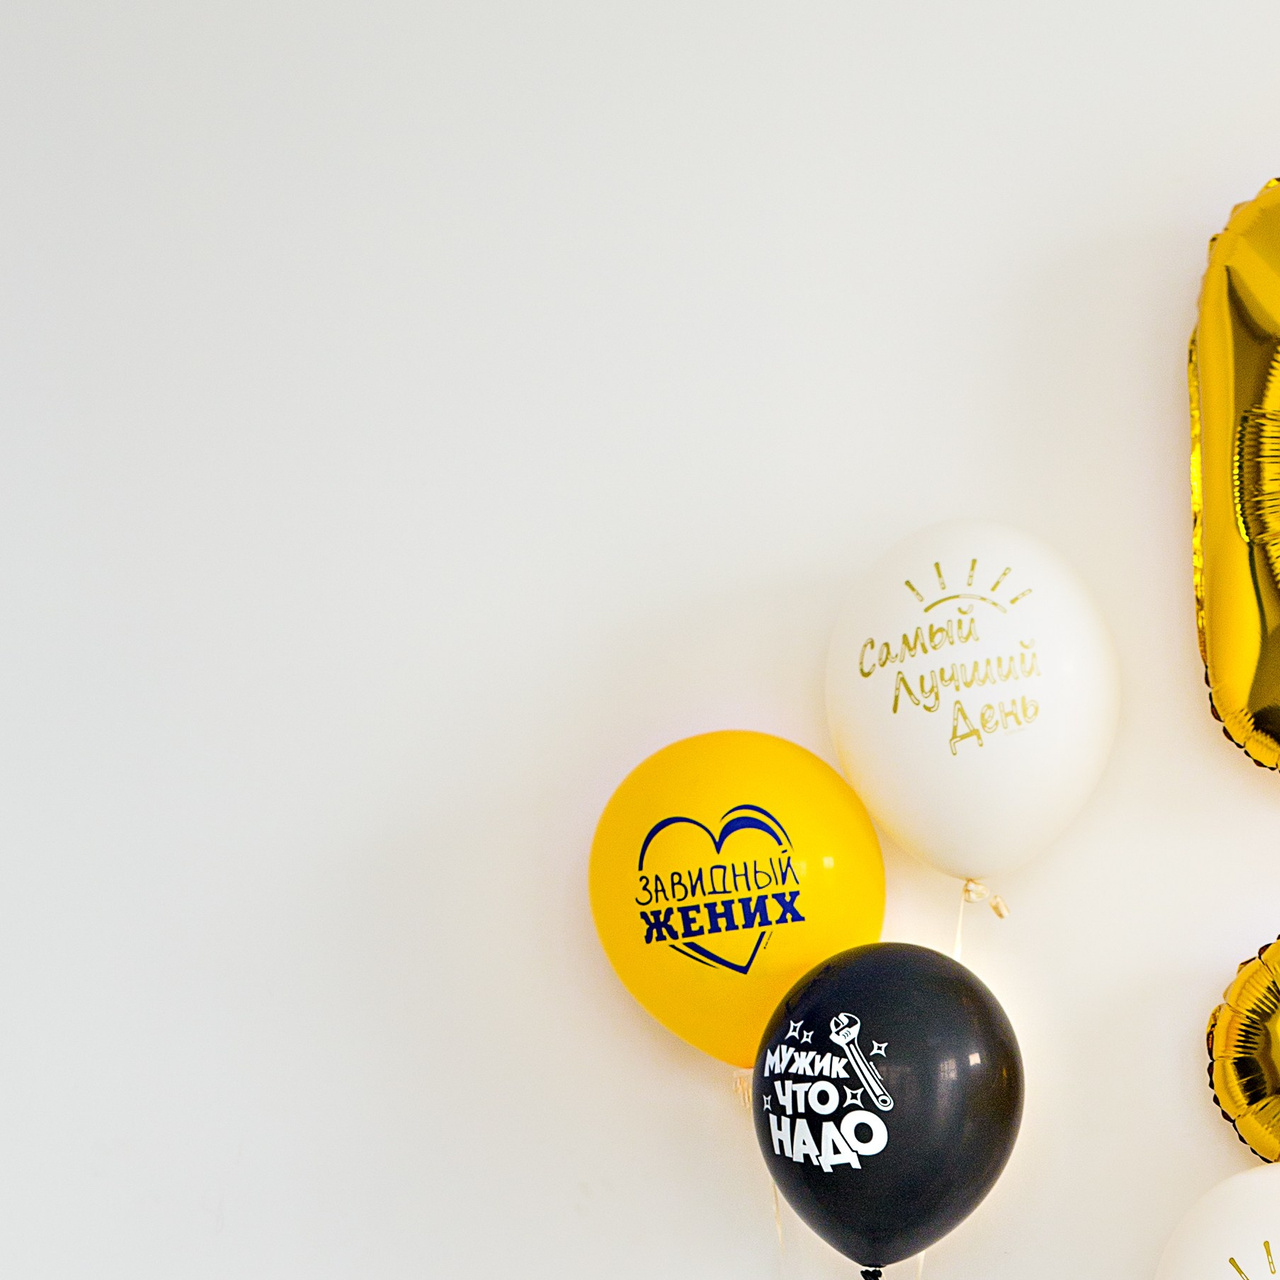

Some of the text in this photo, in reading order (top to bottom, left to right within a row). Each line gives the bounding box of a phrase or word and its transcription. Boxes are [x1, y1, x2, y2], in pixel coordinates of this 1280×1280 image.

[859, 604, 979, 678] Самый
[892, 638, 1041, 714] Лучший
[949, 695, 1039, 756] День
[635, 849, 800, 906] ЗАВИДНЫЙ
[640, 890, 806, 944] ЖЕНИХ
[764, 1044, 850, 1079] МУЖИК
[774, 1080, 840, 1115] ЧТО
[769, 1109, 889, 1173] НАДО
